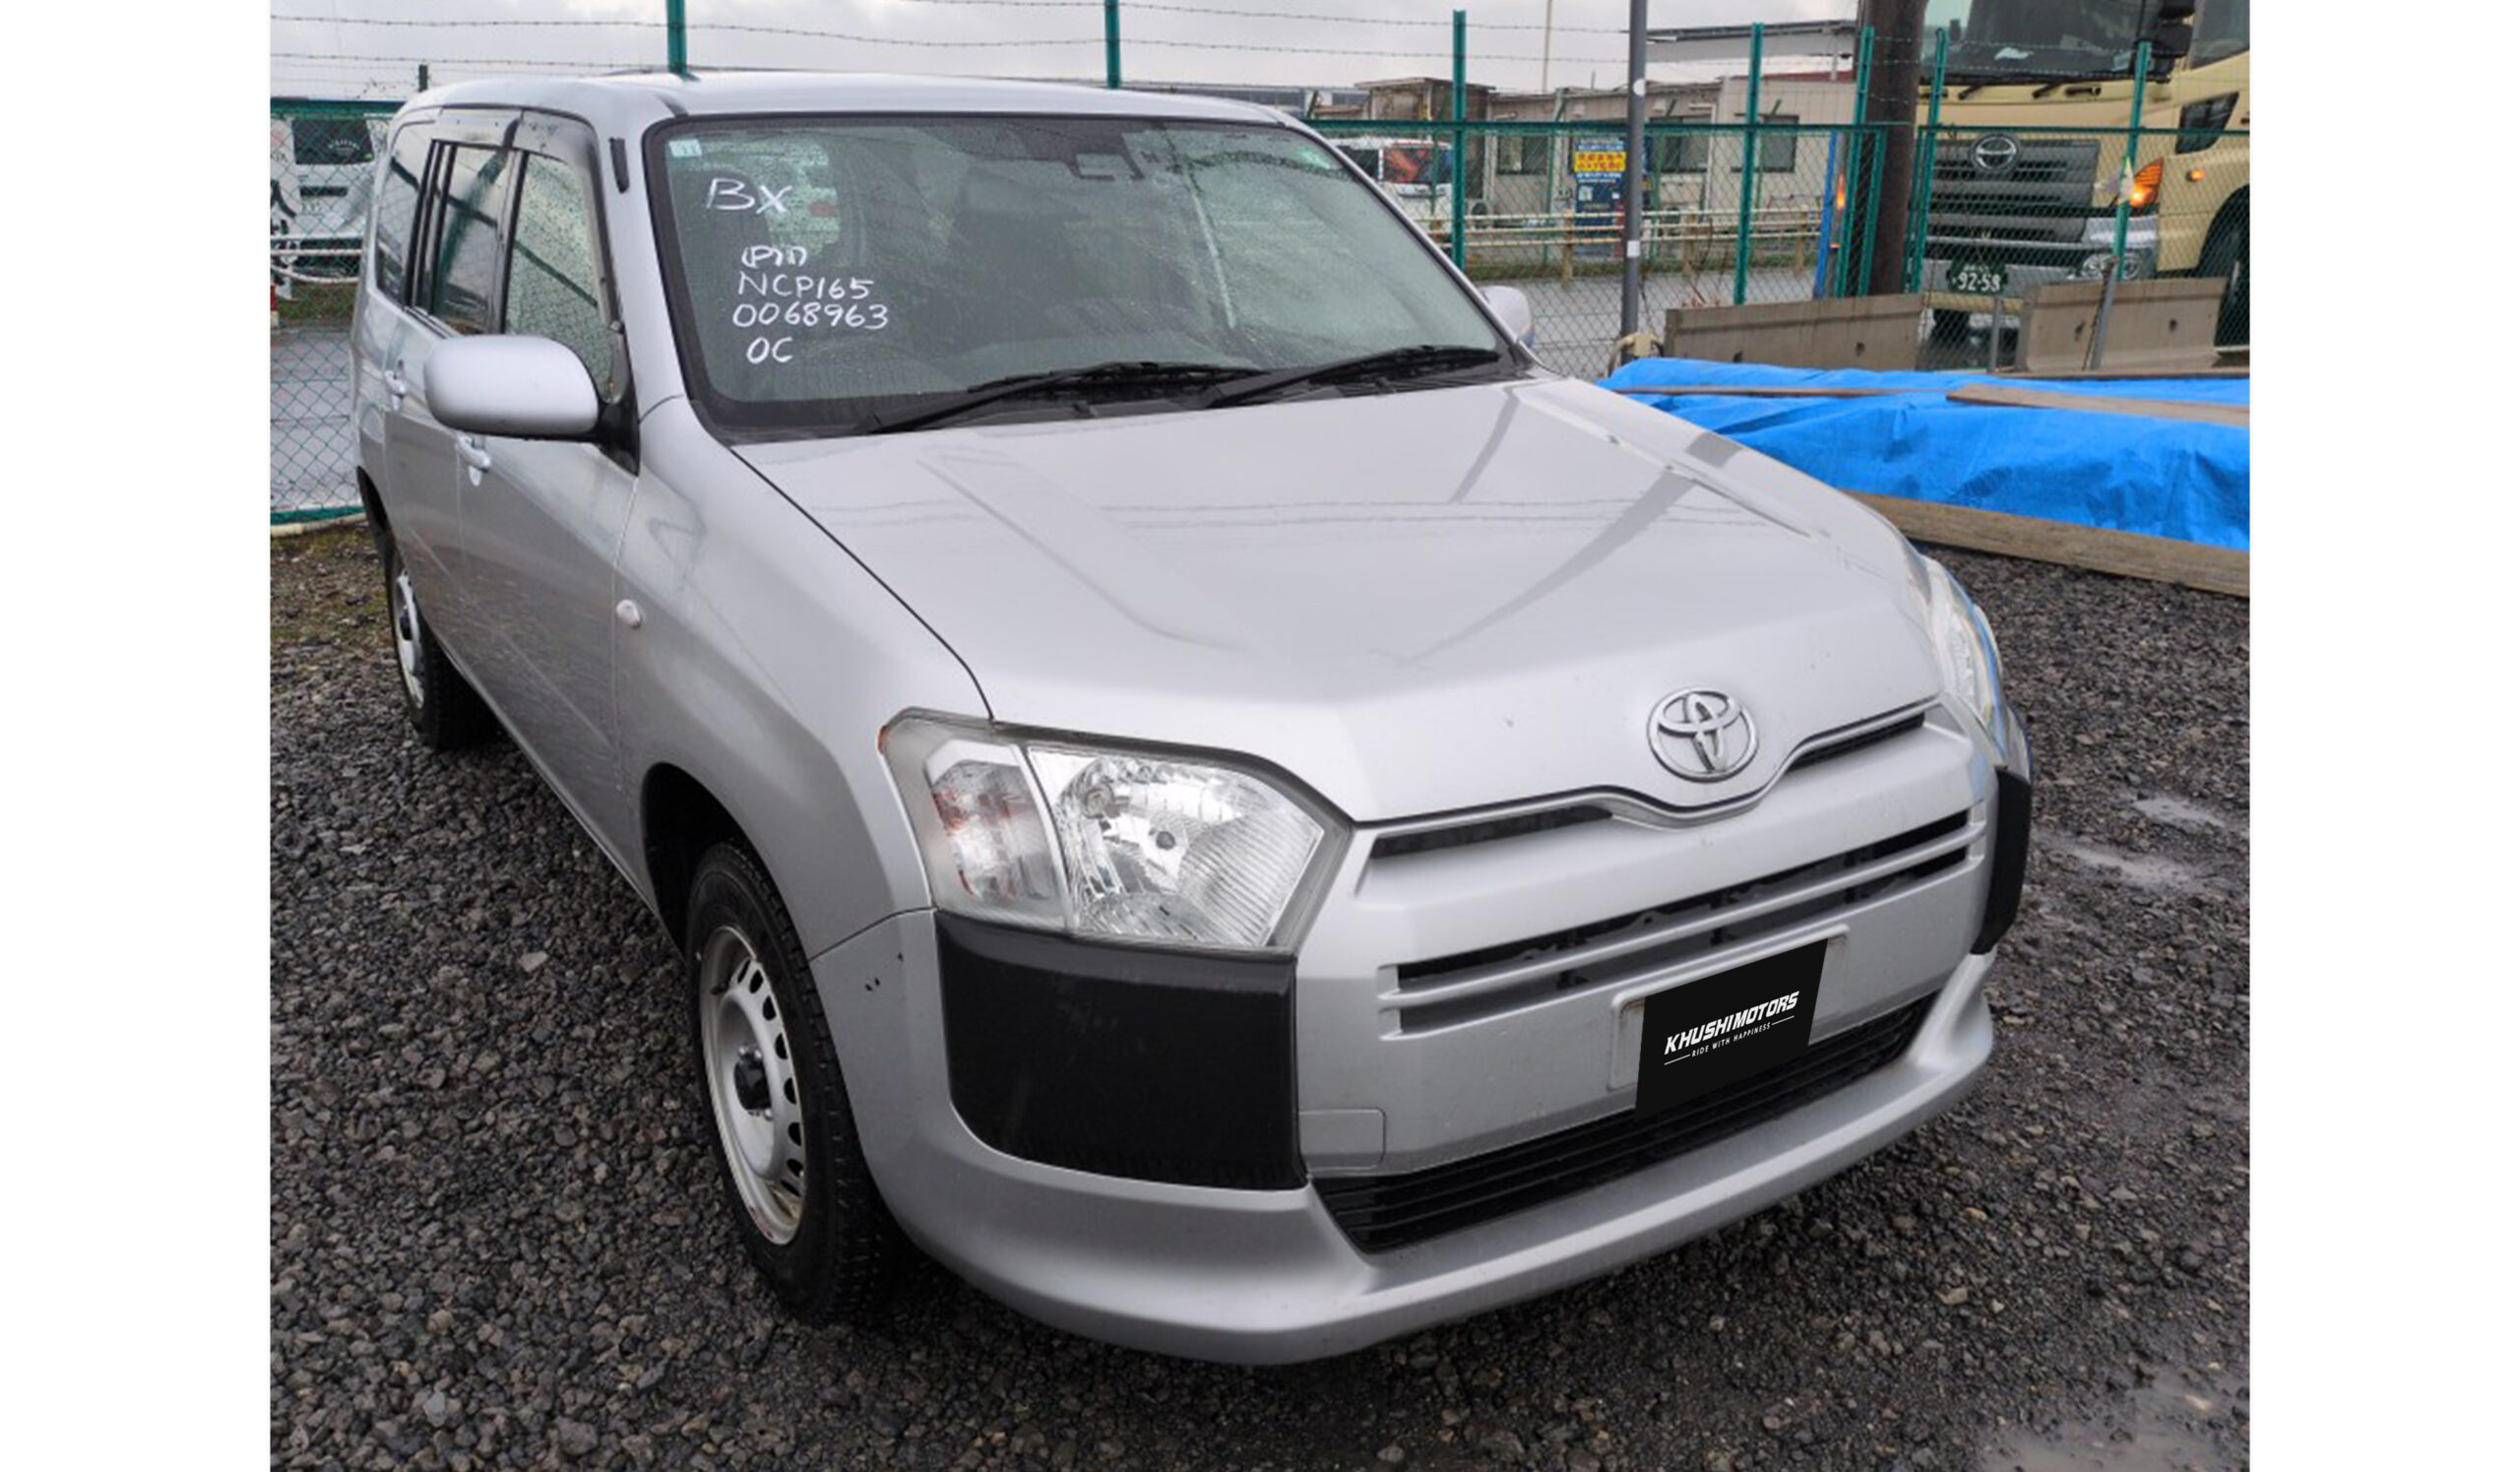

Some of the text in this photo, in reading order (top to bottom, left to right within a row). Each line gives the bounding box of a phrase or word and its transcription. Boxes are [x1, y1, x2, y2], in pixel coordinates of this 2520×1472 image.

[706, 177, 792, 215] BX
[738, 270, 874, 299] NCP165
[731, 301, 888, 330] 0068963
